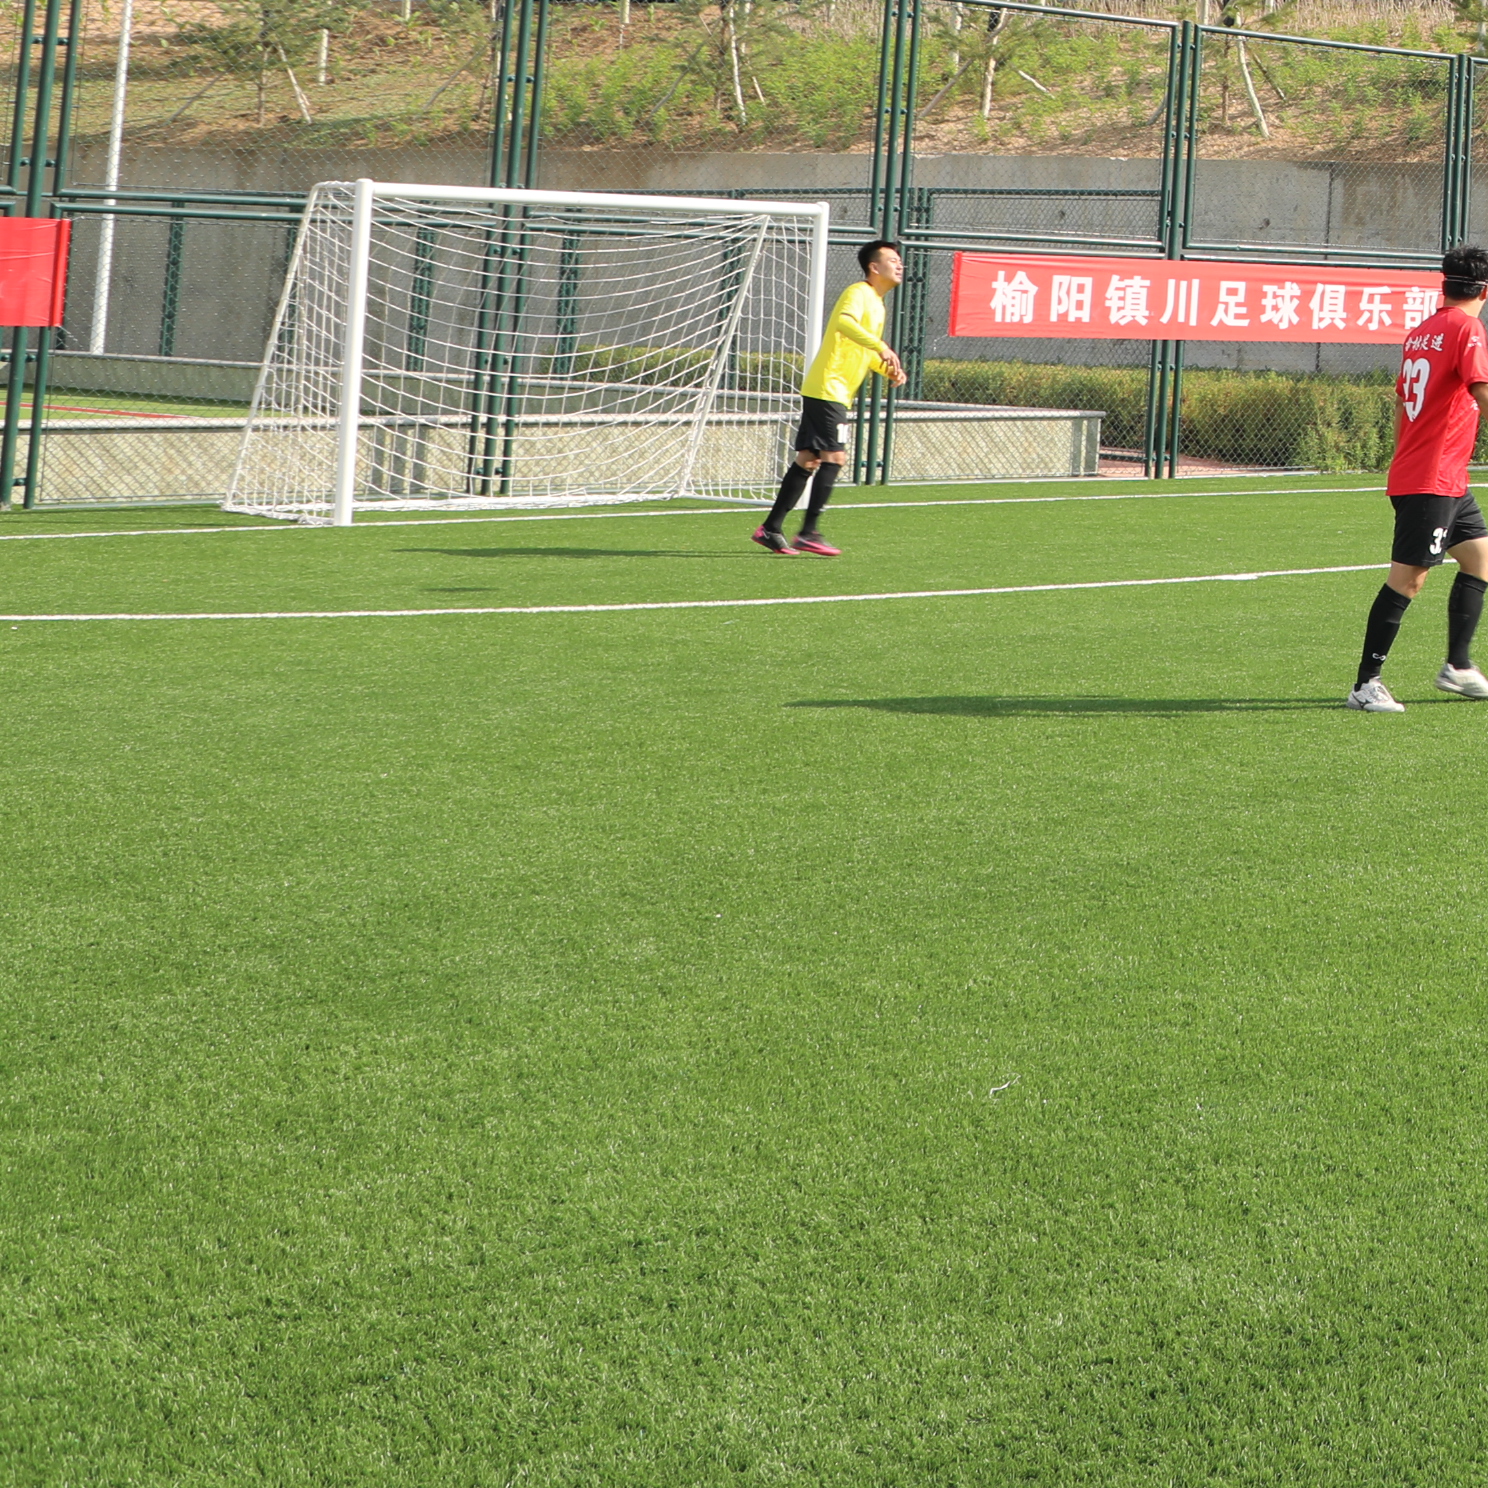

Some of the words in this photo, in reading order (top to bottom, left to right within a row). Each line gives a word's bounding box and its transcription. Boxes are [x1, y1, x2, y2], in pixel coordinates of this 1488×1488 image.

[989, 270, 1441, 331] 榆阳镇川足球俱乐部
[1428, 526, 1448, 556] 3
